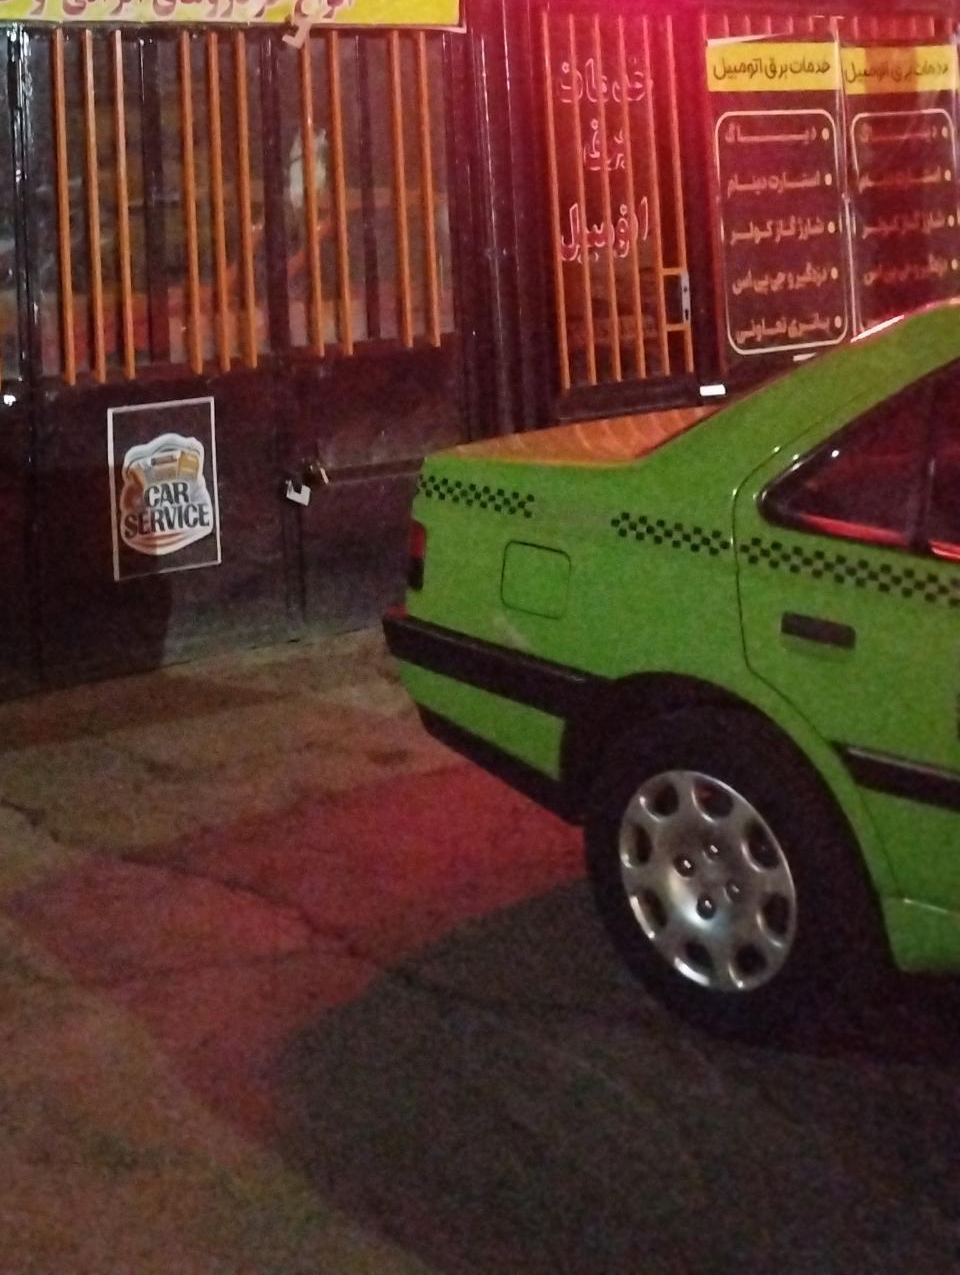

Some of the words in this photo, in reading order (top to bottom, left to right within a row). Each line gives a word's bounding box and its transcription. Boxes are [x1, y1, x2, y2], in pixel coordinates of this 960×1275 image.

[713, 56, 762, 81] اتومبیل
[764, 57, 788, 80] برق
[789, 56, 831, 76] خدمات
[144, 481, 190, 508] CAR
[123, 502, 211, 539] SERVICE
